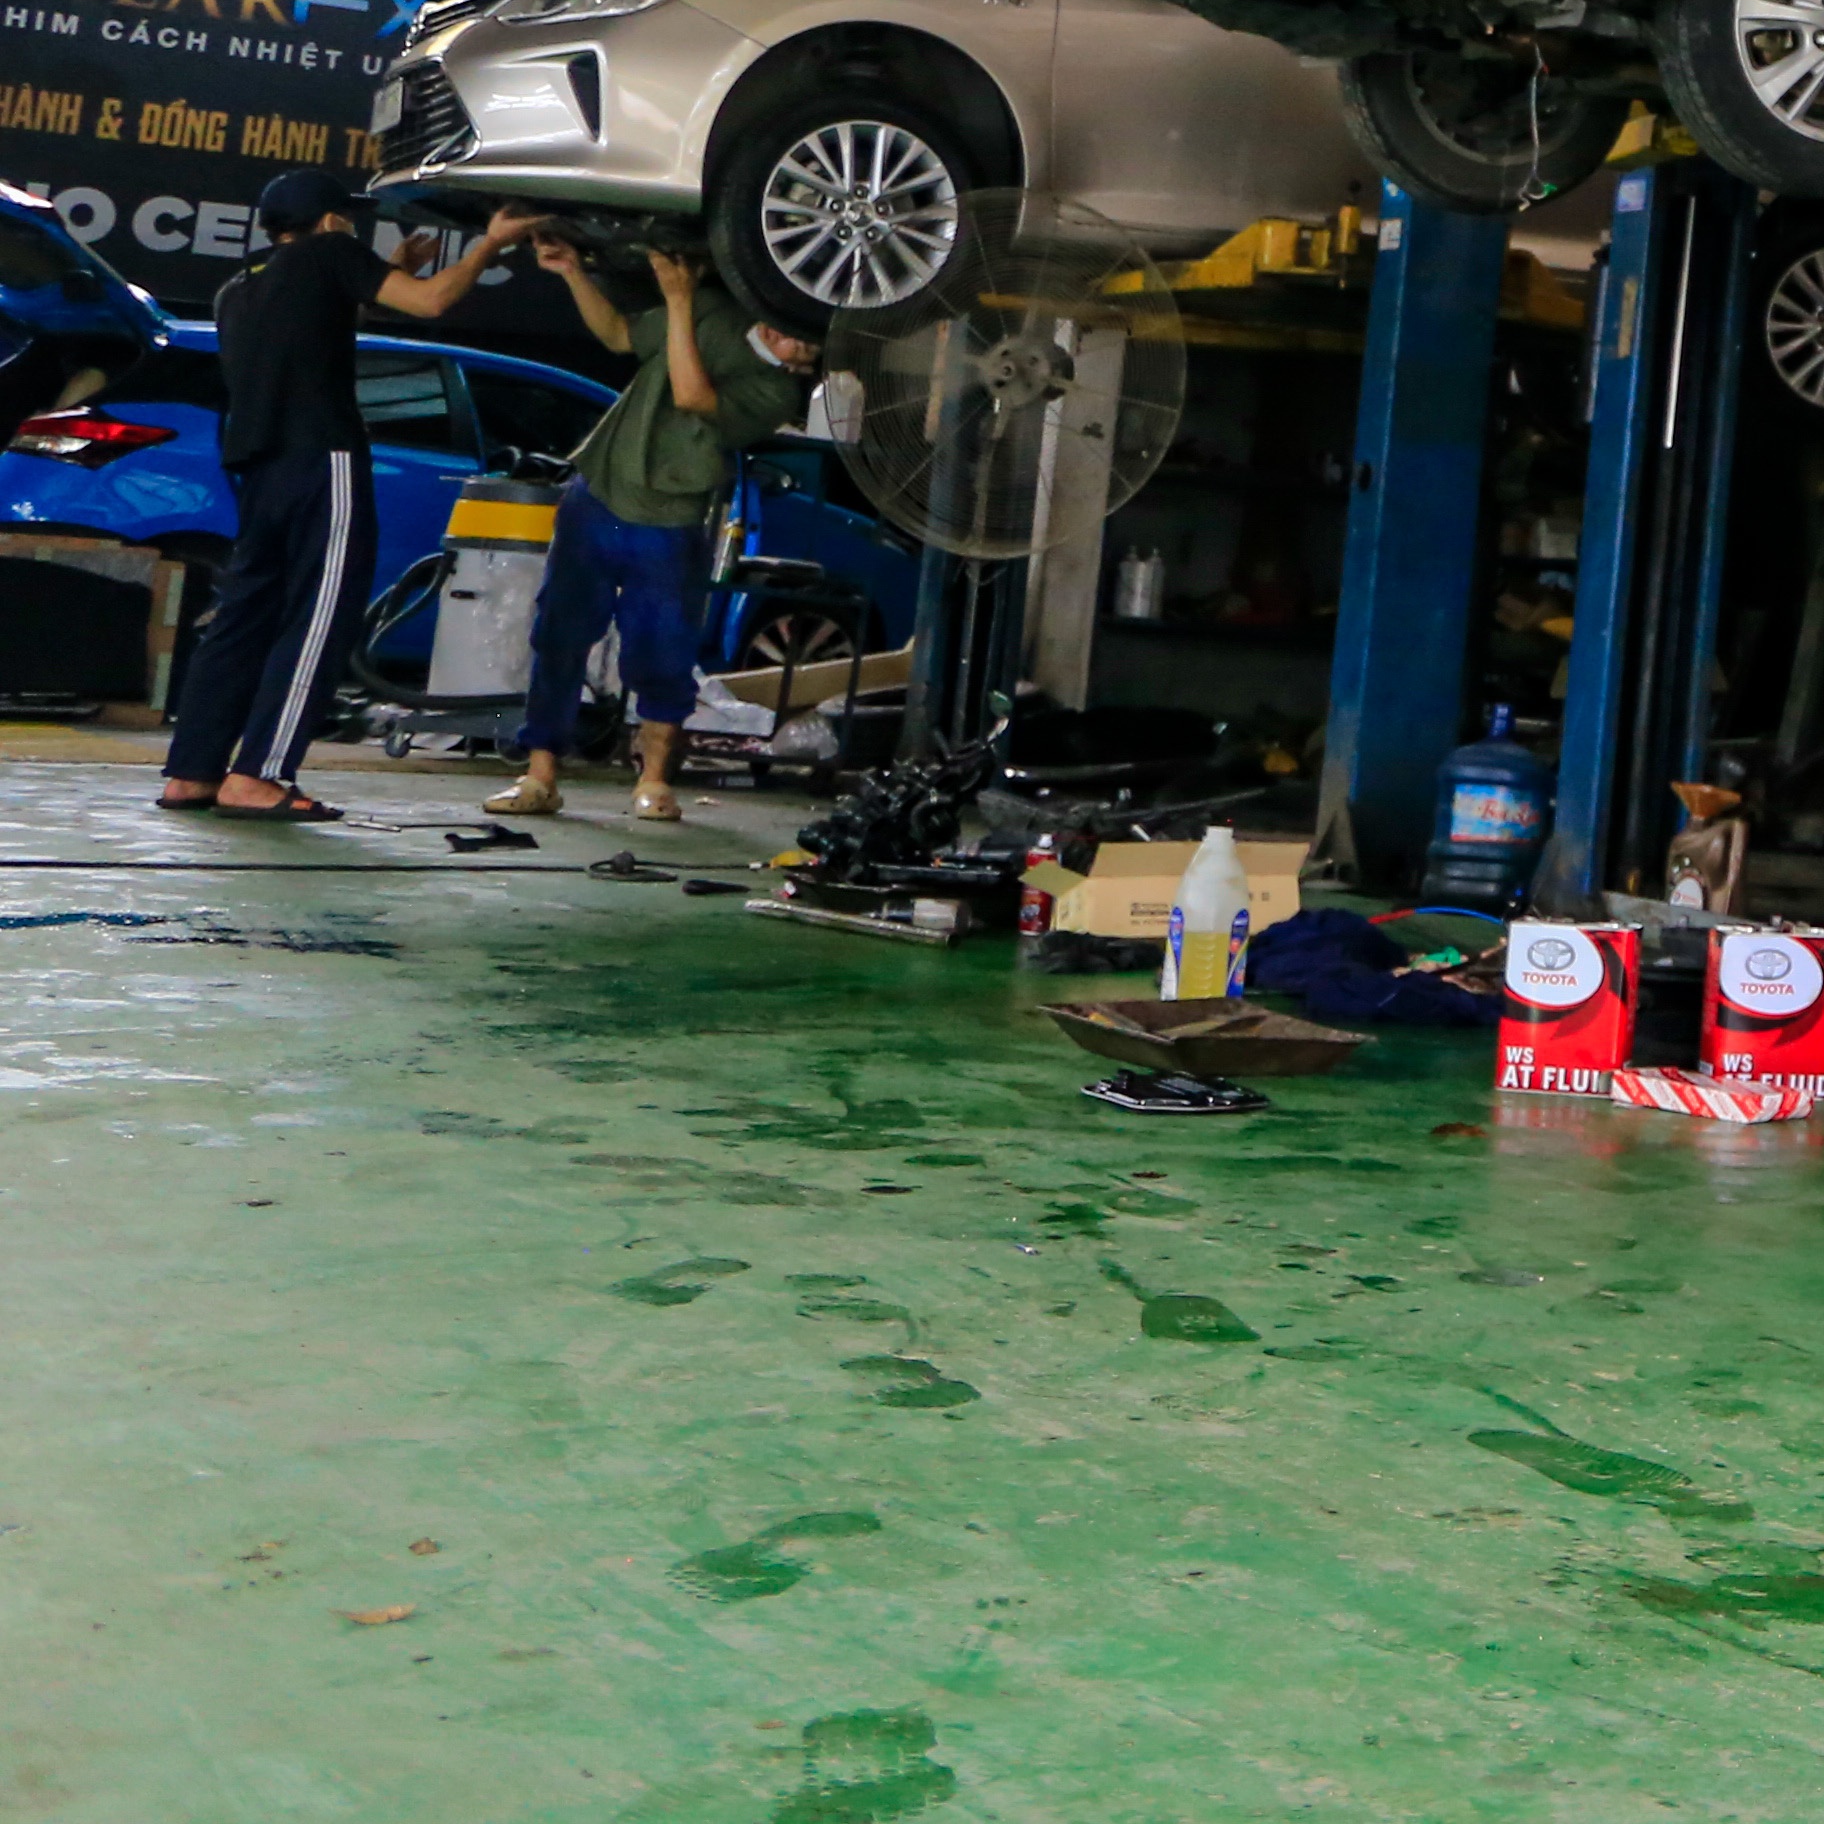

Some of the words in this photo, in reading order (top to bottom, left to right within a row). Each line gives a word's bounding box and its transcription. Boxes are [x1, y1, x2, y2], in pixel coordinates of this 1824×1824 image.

[3, 6, 80, 36] HIM
[101, 17, 209, 53] CÁCH
[228, 36, 344, 71] NHIỆT
[95, 96, 123, 141] &
[240, 113, 330, 165] HÀNH
[1521, 971, 1578, 987] TOYOTA
[1739, 981, 1795, 997] TOYOTA
[1505, 1045, 1535, 1064] WS
[1723, 1053, 1753, 1072] WS
[1501, 1064, 1537, 1090] AT
[1541, 1066, 1600, 1094] FLUI
